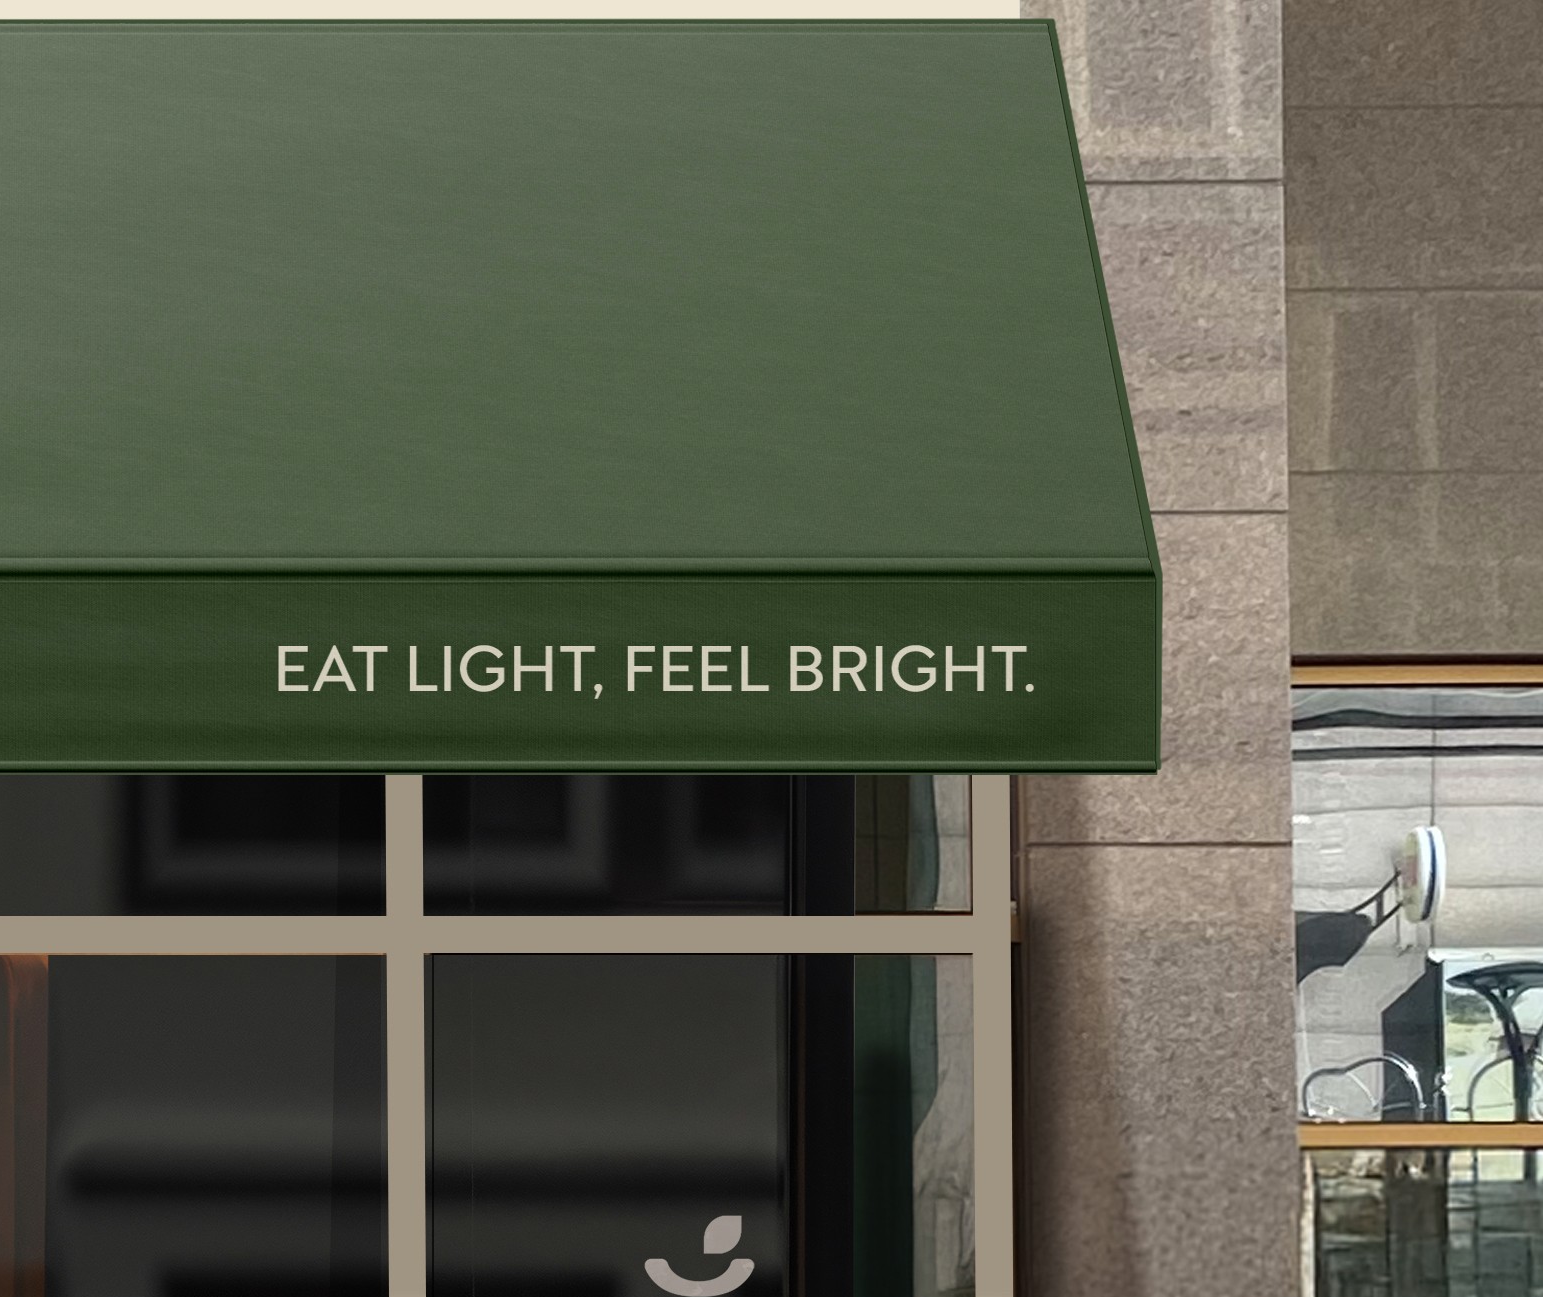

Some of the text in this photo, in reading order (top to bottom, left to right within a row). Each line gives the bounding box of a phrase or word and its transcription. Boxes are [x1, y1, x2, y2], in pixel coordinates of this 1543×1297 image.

[278, 644, 1035, 700] EAT LIGHT, FEEL BRIGHT.
